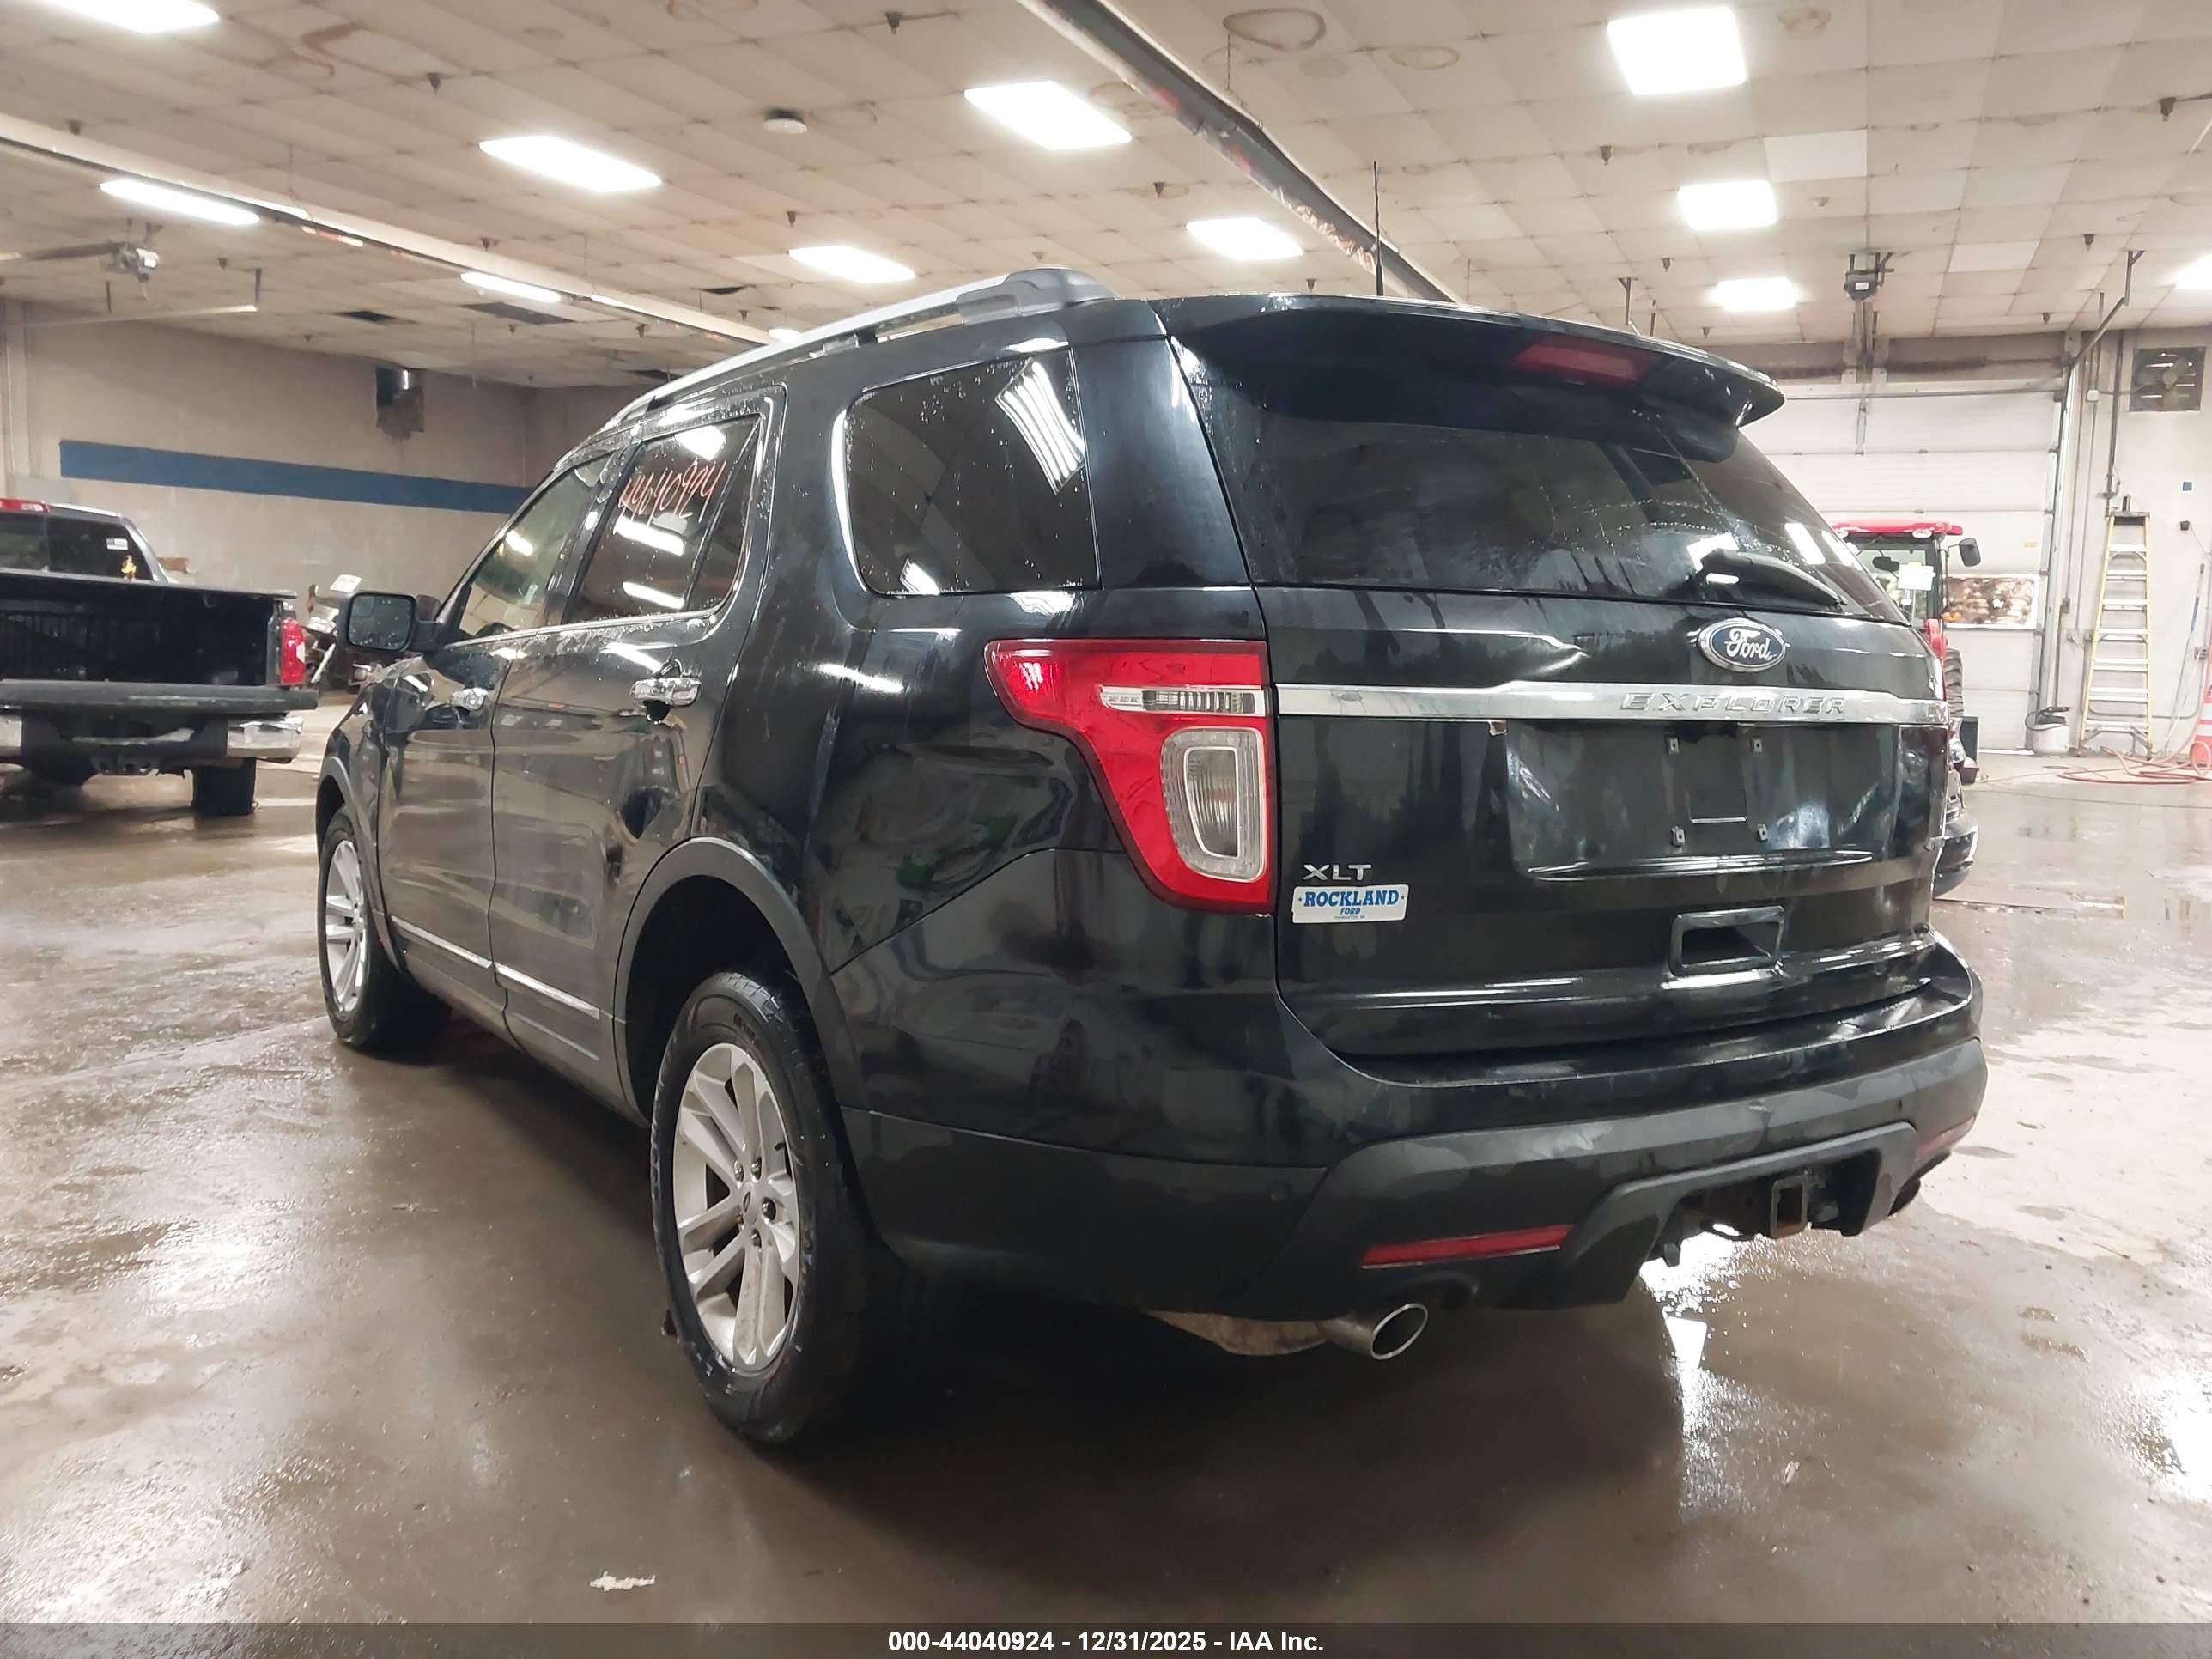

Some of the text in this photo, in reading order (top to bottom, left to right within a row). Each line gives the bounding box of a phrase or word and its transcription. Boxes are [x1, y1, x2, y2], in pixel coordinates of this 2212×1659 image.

[1724, 627, 1778, 660] Ford
[1620, 692, 1847, 714] EXPLORER
[1303, 864, 1372, 881] XLT
[1304, 890, 1400, 908] ROCKLAND
[1340, 907, 1361, 915] FORD
